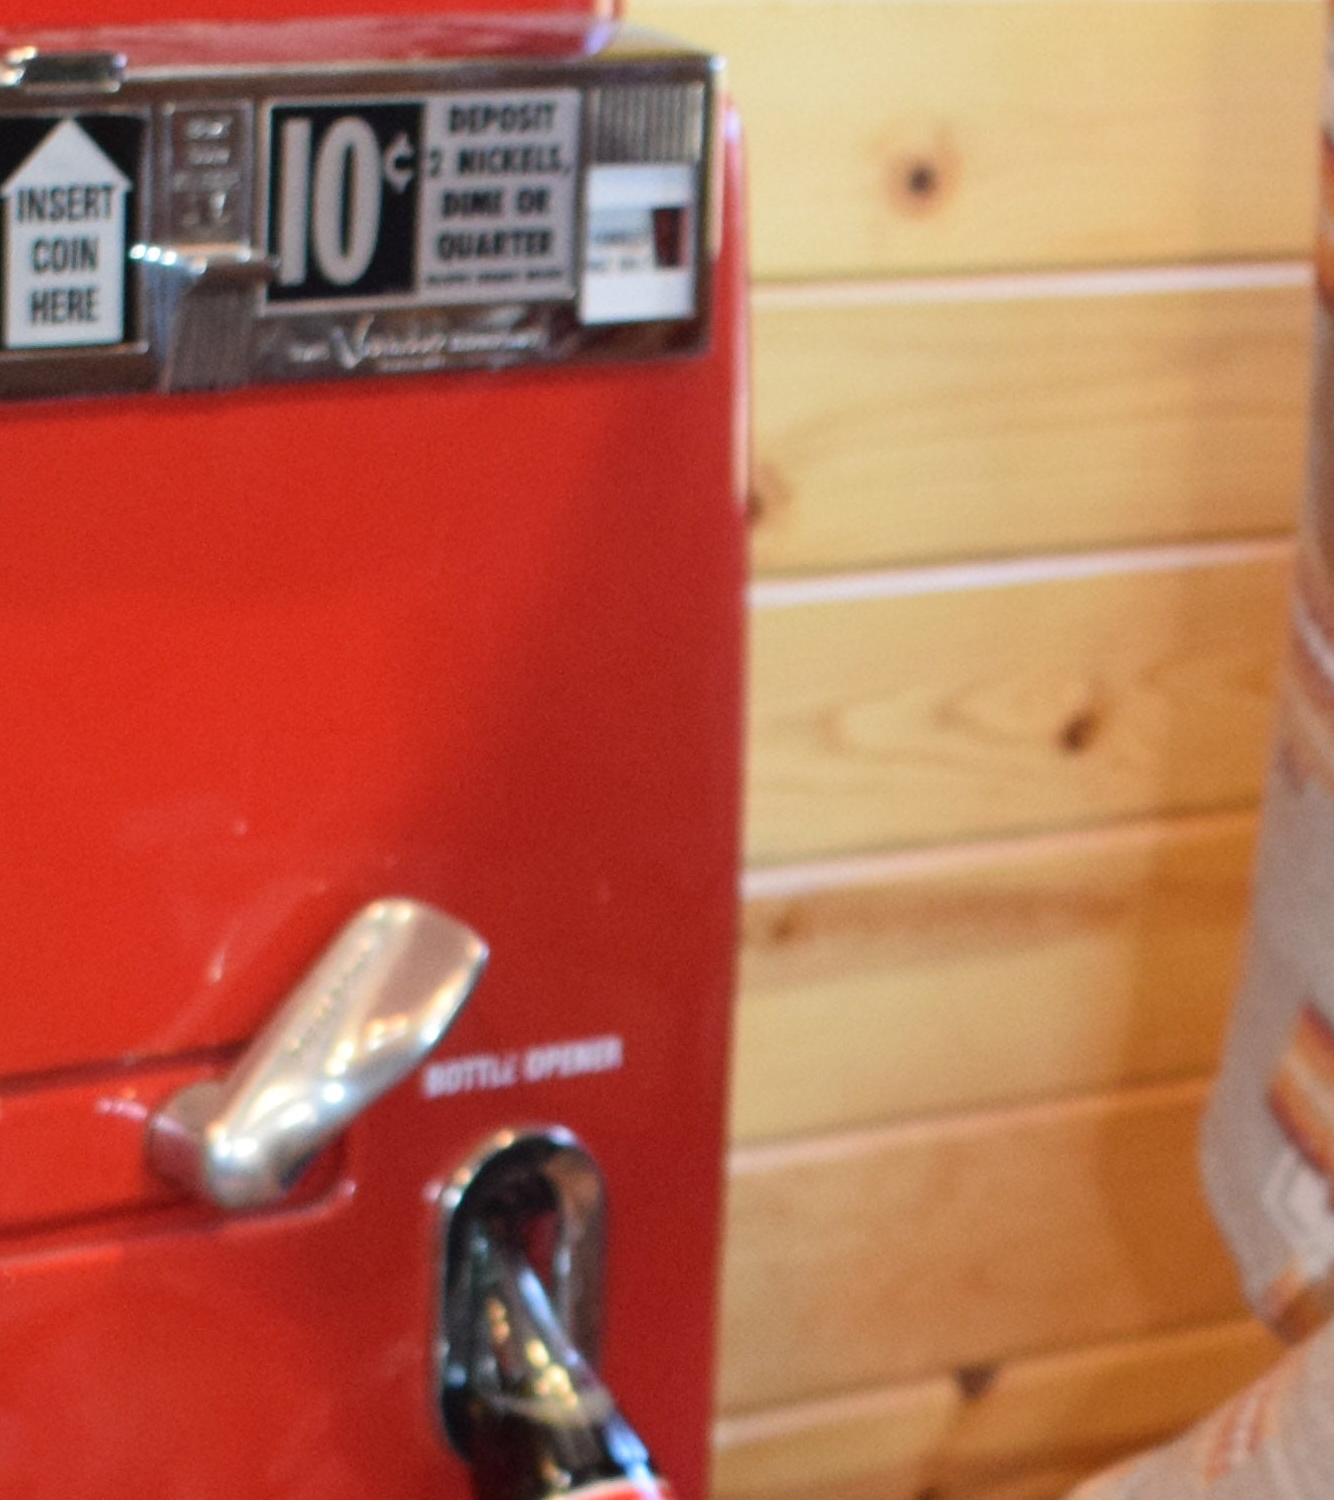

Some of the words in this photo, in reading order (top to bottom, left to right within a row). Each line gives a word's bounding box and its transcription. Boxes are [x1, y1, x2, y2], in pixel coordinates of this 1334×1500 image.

[448, 102, 555, 133] DEPOSIT
[429, 148, 443, 178] 2
[16, 183, 114, 223] INSERT
[441, 187, 503, 218] DIME
[516, 186, 550, 215] OR
[31, 236, 98, 274] COIN
[437, 229, 553, 261] QUARTER
[29, 287, 98, 326] HERE
[424, 1052, 516, 1097] BOTTLE
